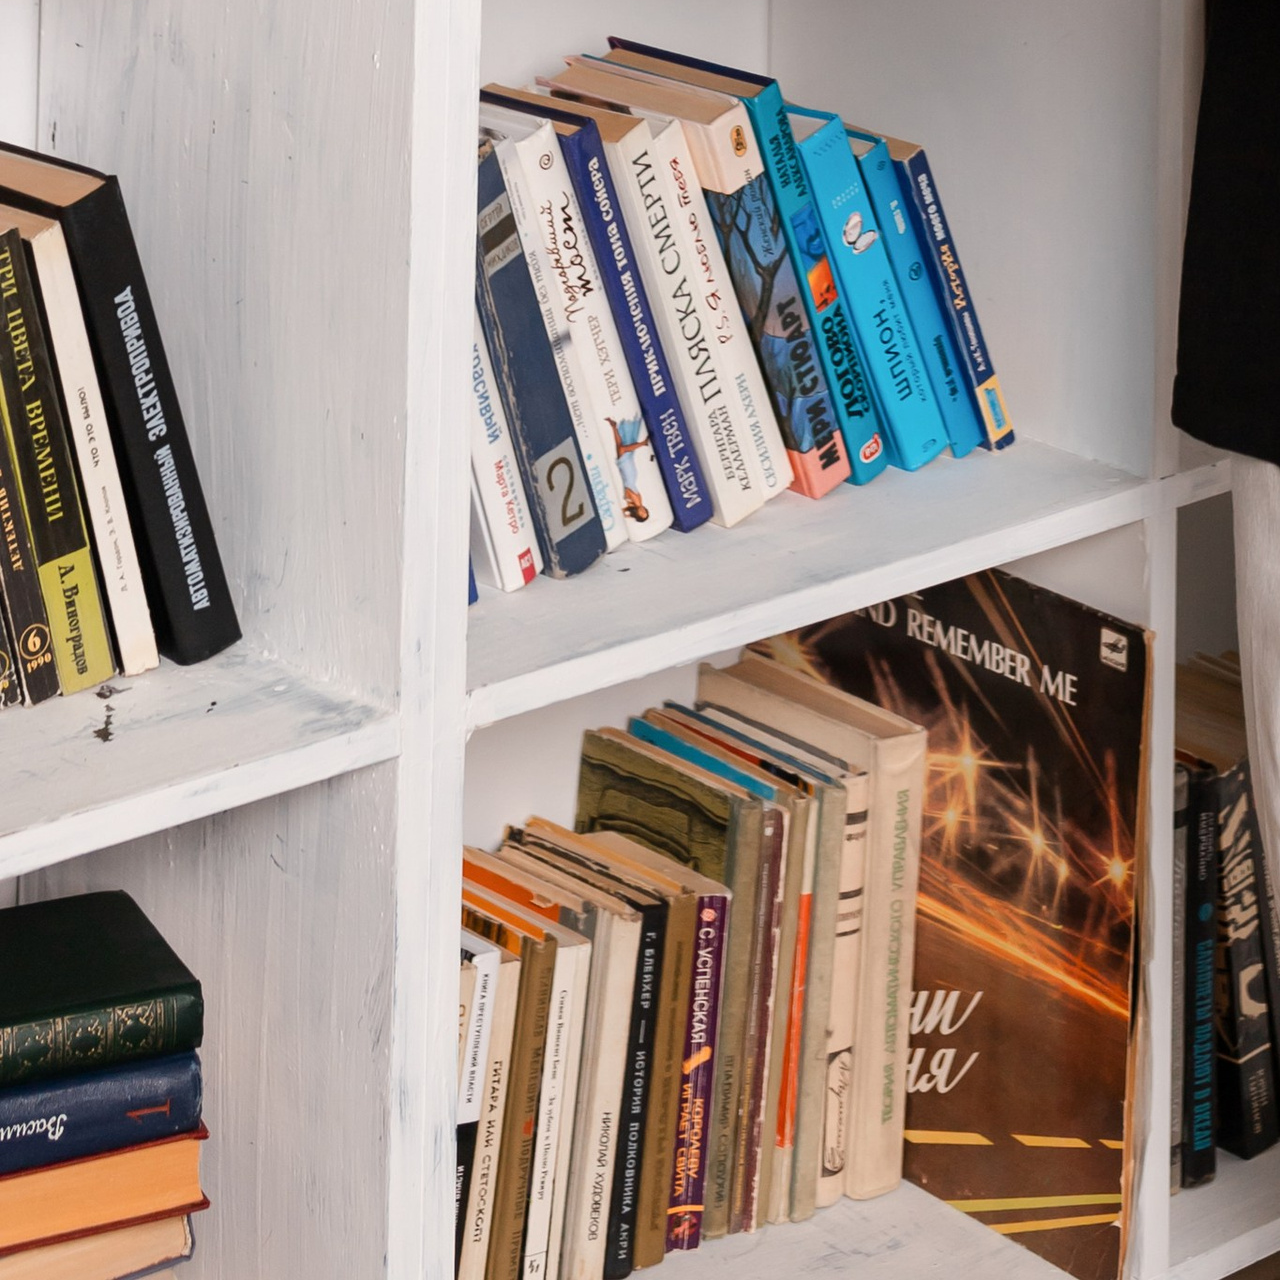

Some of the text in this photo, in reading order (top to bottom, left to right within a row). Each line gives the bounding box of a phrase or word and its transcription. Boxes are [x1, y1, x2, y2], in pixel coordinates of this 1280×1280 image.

[669, 156, 692, 208] тебя
[769, 133, 793, 190] НАТАЛЬЯ
[631, 149, 723, 406] ПЛЯСКА СМЕРТИ
[688, 212, 715, 284] люблю
[0, 246, 63, 524] ТРИ ЦВЕТА ВРЕМЕНИ
[586, 314, 612, 367] ХЭТЧЕР
[776, 295, 842, 471] МЕРИ СТЮАРТ
[821, 316, 864, 419] ЛОГОВО
[832, 302, 871, 415] СКОРПИОНА
[602, 367, 623, 408] ТЕРИ
[734, 372, 778, 489] СЕСИЛИЯ АХЕРН
[85, 423, 97, 444] ЭТО
[90, 448, 99, 468] ЧТО
[717, 404, 752, 492] КЕЛЛЕРМАН
[153, 443, 211, 611] АВТОМАТИЗИРОВАННЫЙ
[493, 458, 520, 535] Марта Кетро
[546, 456, 584, 527] 2
[26, 653, 52, 675] 1990
[61, 584, 89, 677] Виноградов
[905, 607, 1079, 707] REMEMBER ME
[690, 948, 715, 1044] УСПЕНСКАЯ
[881, 1061, 898, 1126] ТЕОРИЯ
[891, 788, 911, 893] УПРАВЛЕНИЯ
[487, 1059, 503, 1114] ГИТАРА
[620, 947, 656, 1215] БЛЕЙХЕР ИСТОРИЯ ПОЛКОВНИКА
[484, 1118, 498, 1149] ИЛИ
[587, 1111, 612, 1241] НИКОЛАЙ ХУДОВЕКОВ
[672, 1082, 694, 1198] ИГРАЕТ СВИТА
[686, 1098, 706, 1180] КОРОЛЕВУ
